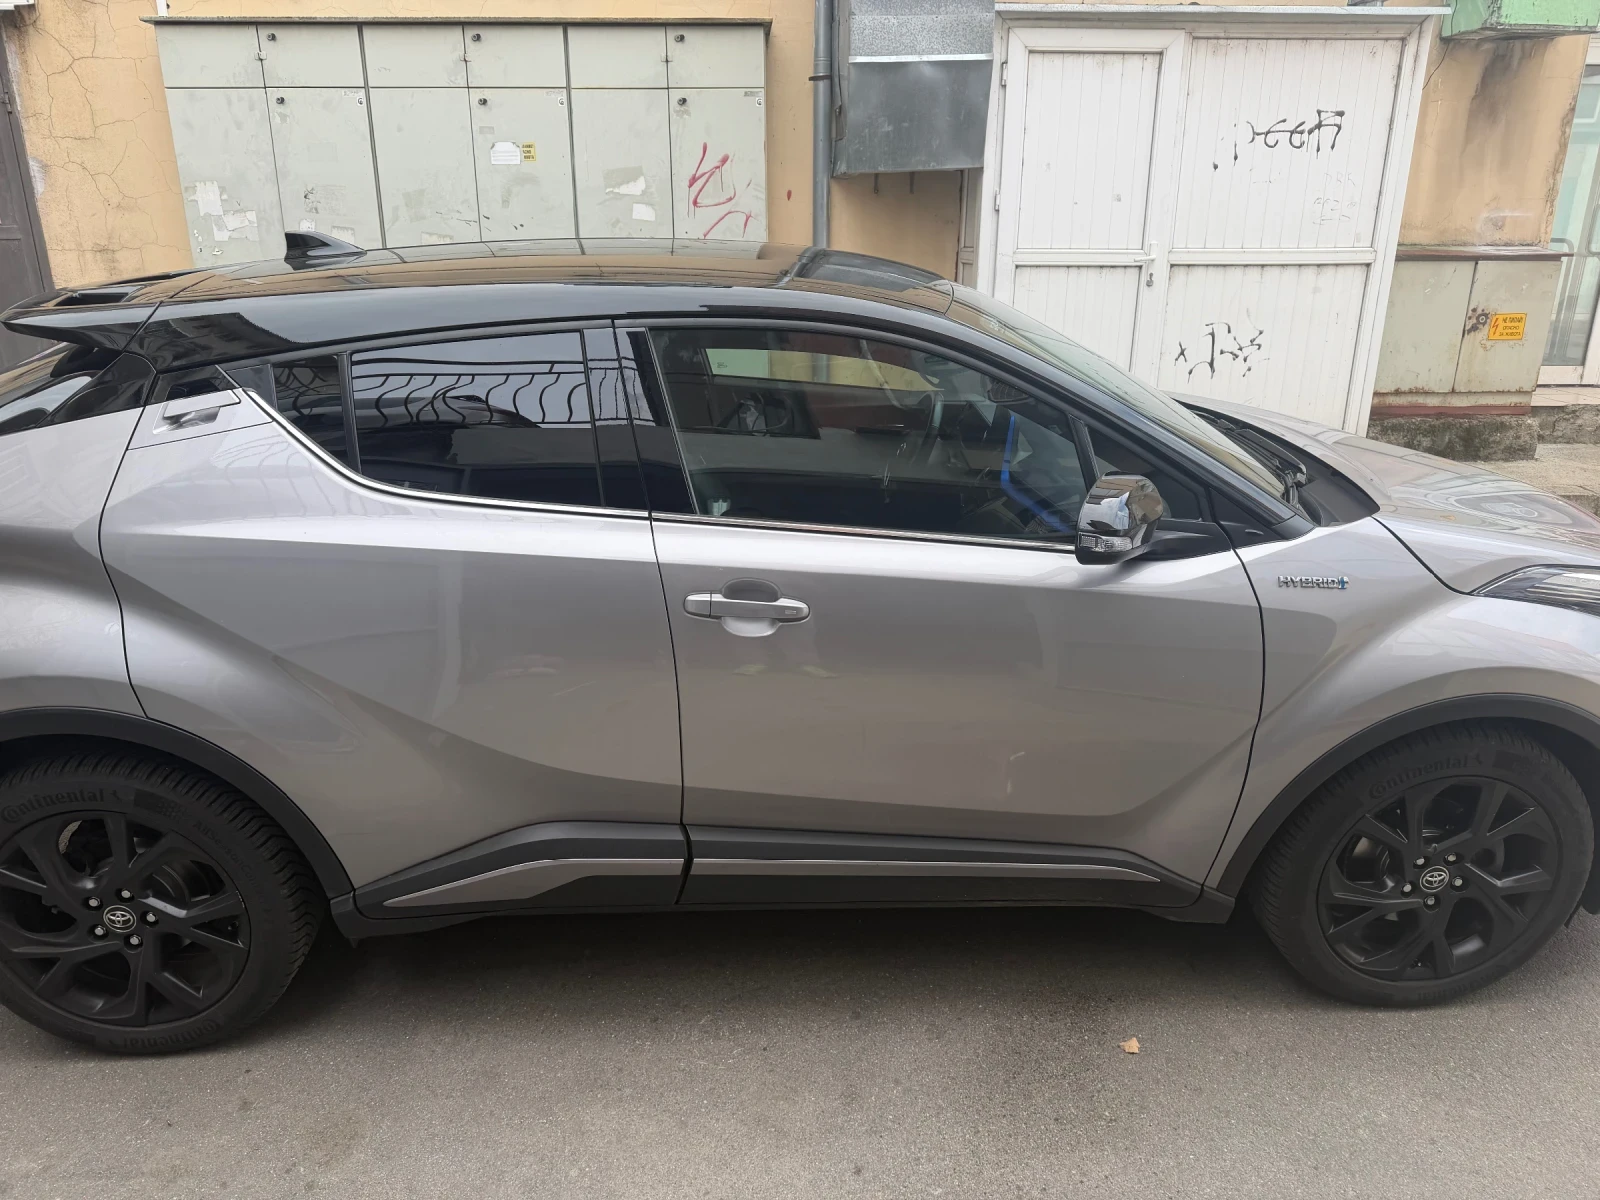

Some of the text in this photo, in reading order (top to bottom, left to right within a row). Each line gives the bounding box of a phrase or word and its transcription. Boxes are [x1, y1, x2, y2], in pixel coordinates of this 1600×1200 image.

[1277, 575, 1338, 589] HYBRID
[1369, 753, 1468, 800] Continental
[1, 787, 105, 824] Continental
